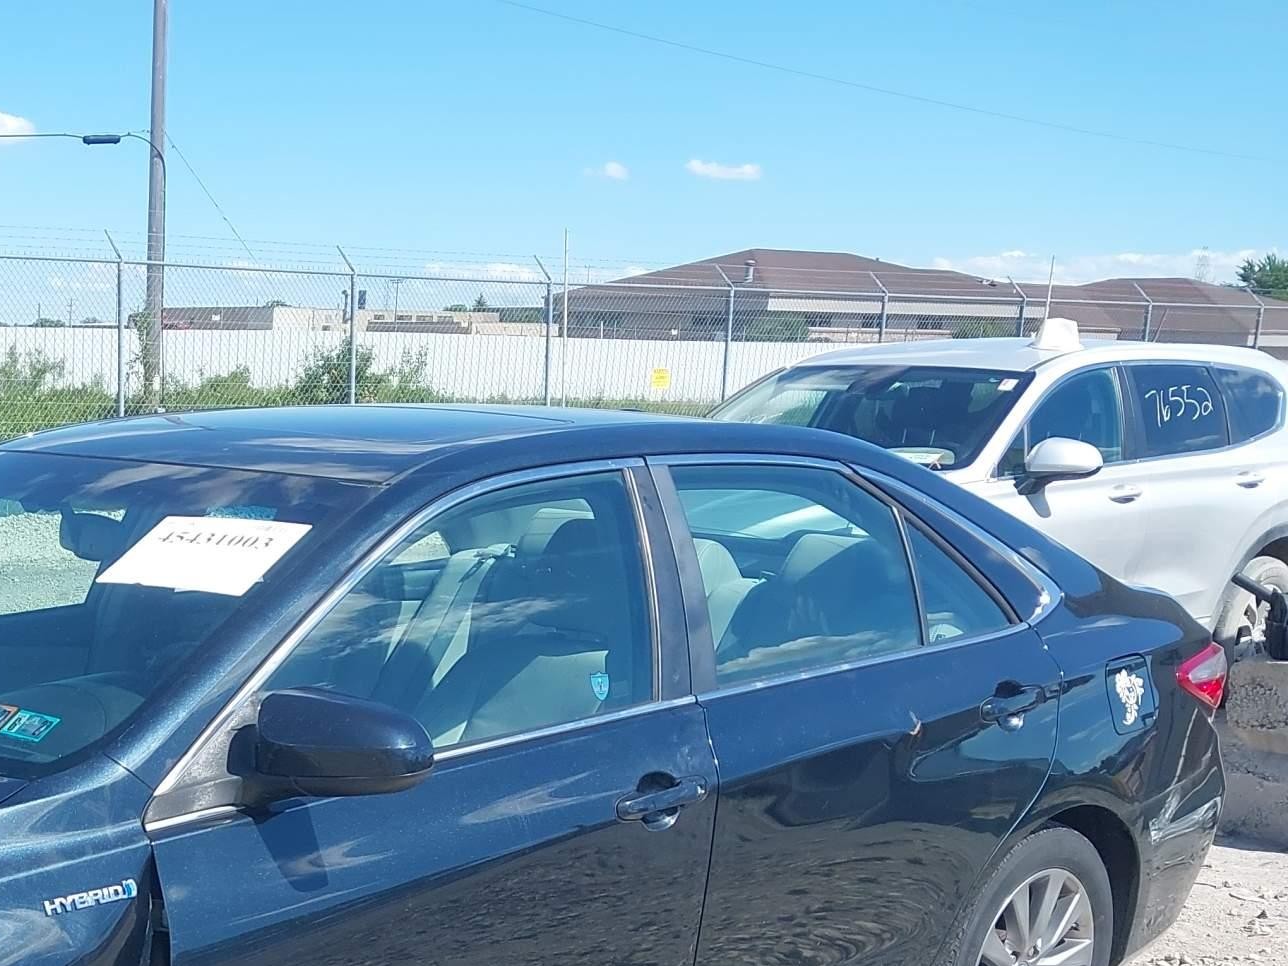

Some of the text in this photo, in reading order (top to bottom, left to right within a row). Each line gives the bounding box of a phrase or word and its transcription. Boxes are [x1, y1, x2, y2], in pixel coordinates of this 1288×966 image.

[1144, 384, 1214, 428] 76552
[158, 531, 274, 550] 45431003
[43, 885, 125, 917] HYBRID
